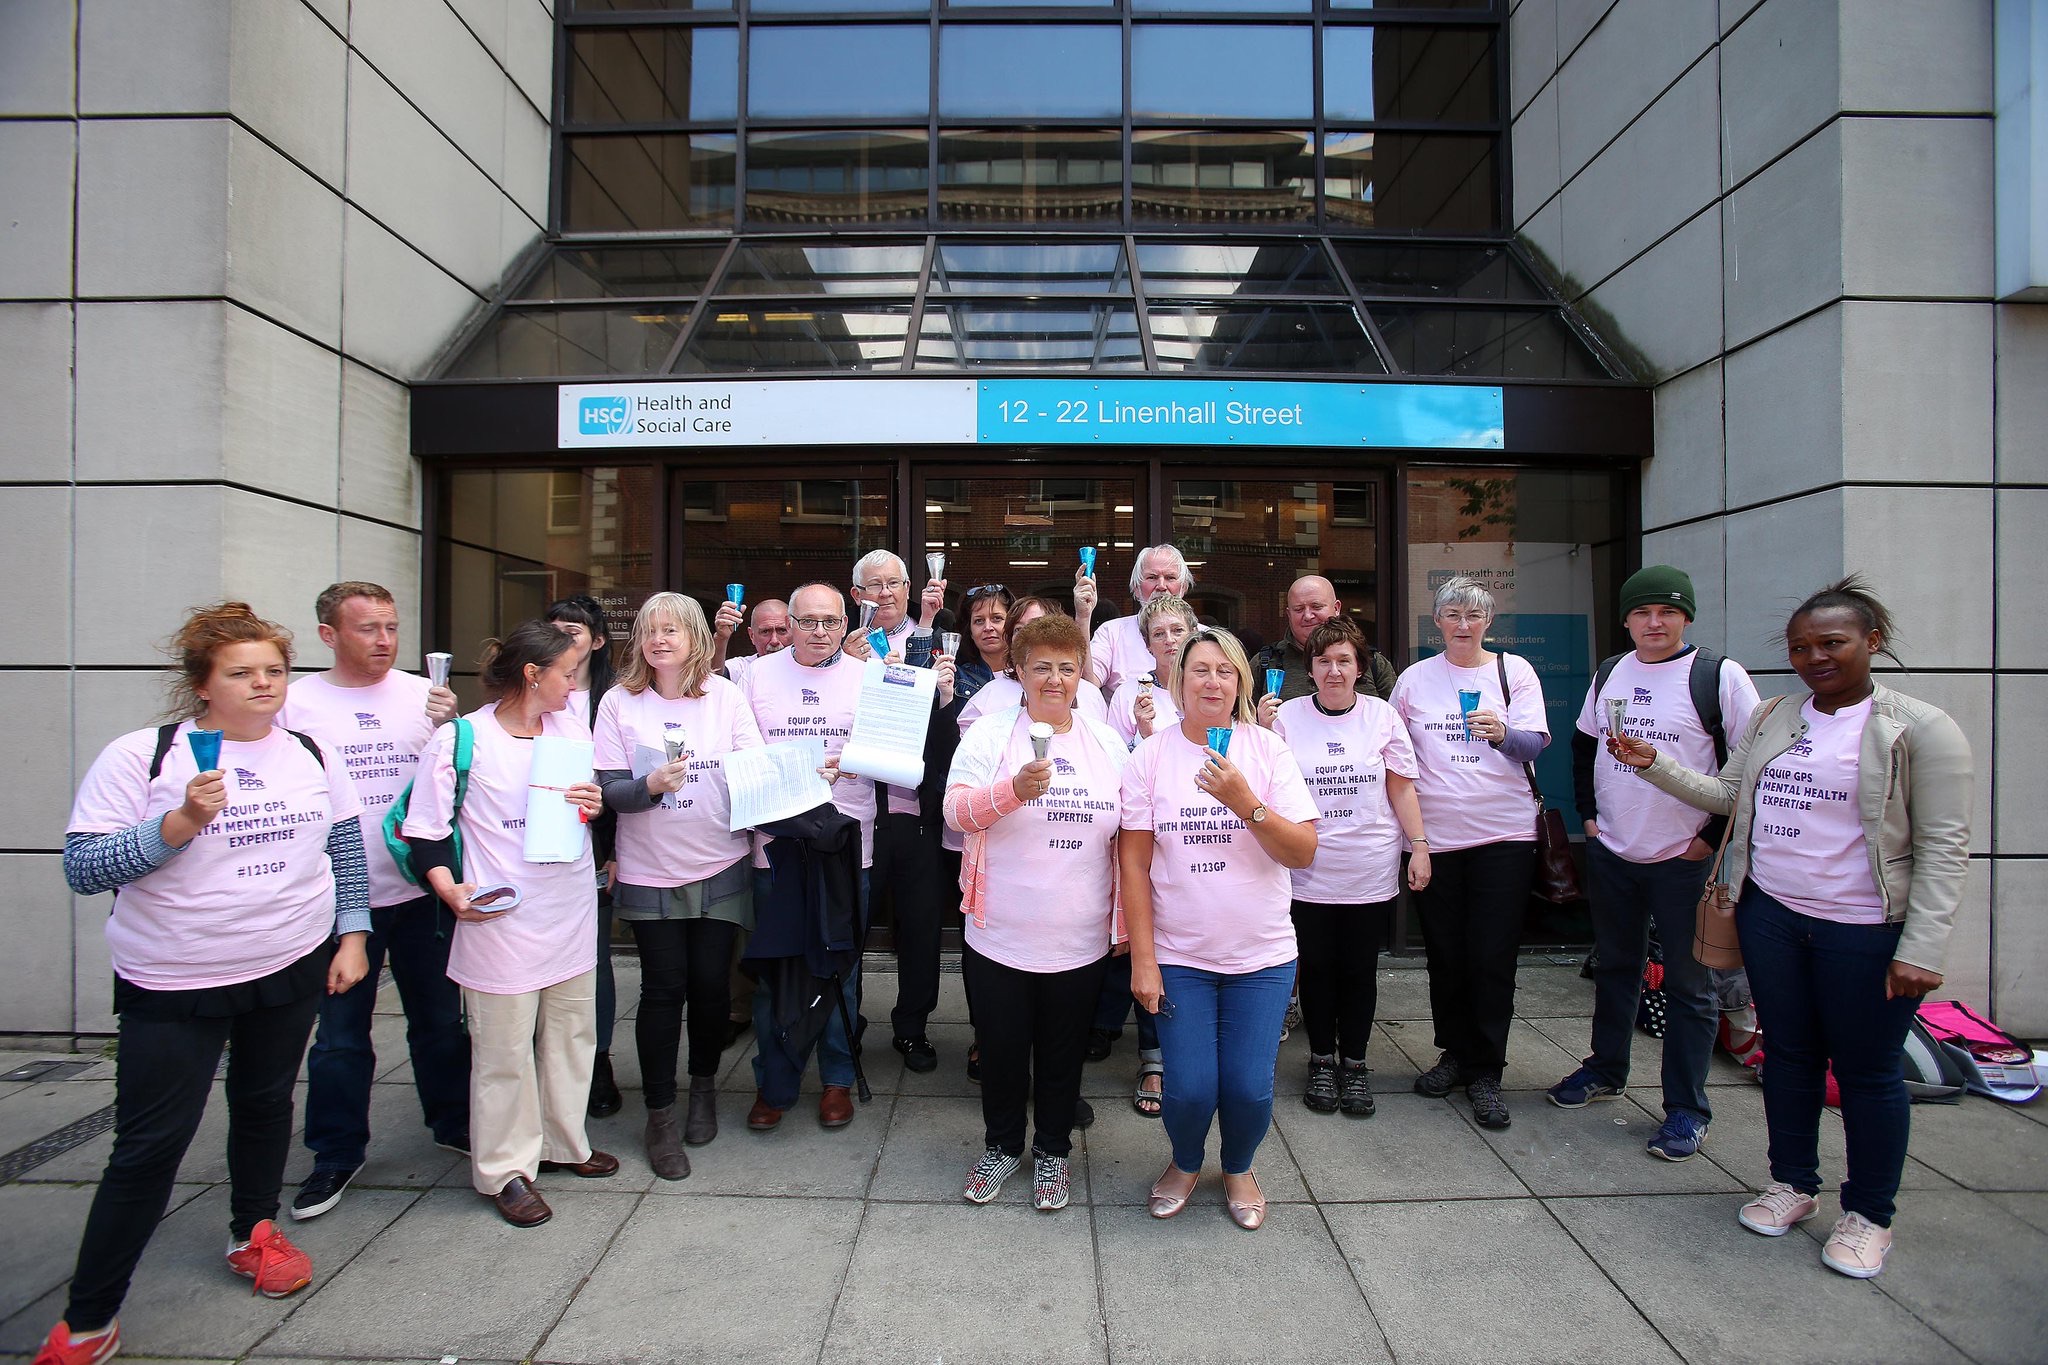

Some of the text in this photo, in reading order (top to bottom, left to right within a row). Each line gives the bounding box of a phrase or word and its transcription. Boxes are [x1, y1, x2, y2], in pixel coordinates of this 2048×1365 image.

[636, 394, 732, 411] Health and
[584, 407, 624, 425] HSC
[998, 400, 1029, 423] 12
[1056, 400, 1089, 424] 22
[1099, 400, 1216, 425] Linenhall
[1226, 402, 1303, 426] Street
[636, 417, 732, 434] Social Care
[1461, 568, 1514, 578] Health and
[1494, 581, 1515, 590] Care
[602, 608, 639, 618] creenin
[608, 622, 628, 630] ntre
[802, 696, 820, 704] PPR
[1632, 696, 1652, 704] PPR
[359, 720, 381, 728] PPR
[788, 716, 826, 726] EQUIP GPS
[1424, 722, 1465, 730] WITH MENT
[1624, 716, 1655, 727] UIP GPS
[768, 728, 849, 737] WITH MENTAL HEALTH
[1622, 728, 1680, 742] NTAL HEALTH
[344, 742, 394, 755] EQUIP GPS
[1328, 746, 1346, 754] PPR
[346, 754, 419, 768] MENTAL HEALTH
[689, 760, 720, 771] HEALTH
[1450, 755, 1480, 764] #123GP
[349, 767, 400, 780] EXPERTISE
[1056, 765, 1076, 773] PPR
[1316, 764, 1354, 775] EQUIP GPS
[1614, 763, 1636, 773] #123
[1304, 774, 1376, 786] TH MENTAL HEALTH
[1764, 767, 1812, 782] EQUIP GPS
[238, 778, 266, 788] PPR
[1072, 787, 1088, 796] GPS
[1318, 786, 1358, 796] EXPERTISE
[1762, 781, 1800, 796] MENTAL
[1804, 786, 1848, 801] HEALTH
[360, 794, 394, 806] 123GP
[1024, 799, 1115, 812] ITH MENTAL HEALTH
[1762, 795, 1812, 810] EXPERTISE
[223, 800, 286, 818] EQUIP GPS
[1180, 806, 1228, 818] EQUIP GPS
[1324, 810, 1353, 818] #123GP
[198, 810, 324, 836] TH MENTAL HEALTH
[502, 818, 526, 830] WITH
[1047, 812, 1094, 824] EXPERTISE
[1158, 820, 1250, 832] WITH MENTAL HEAL
[1764, 824, 1800, 838] #123GP
[230, 829, 295, 848] EXPERTISE
[1049, 839, 1082, 850] #123GP
[1184, 834, 1232, 845] EXPERTISE
[237, 861, 286, 878] #123GP
[1190, 862, 1226, 874] #123GP
